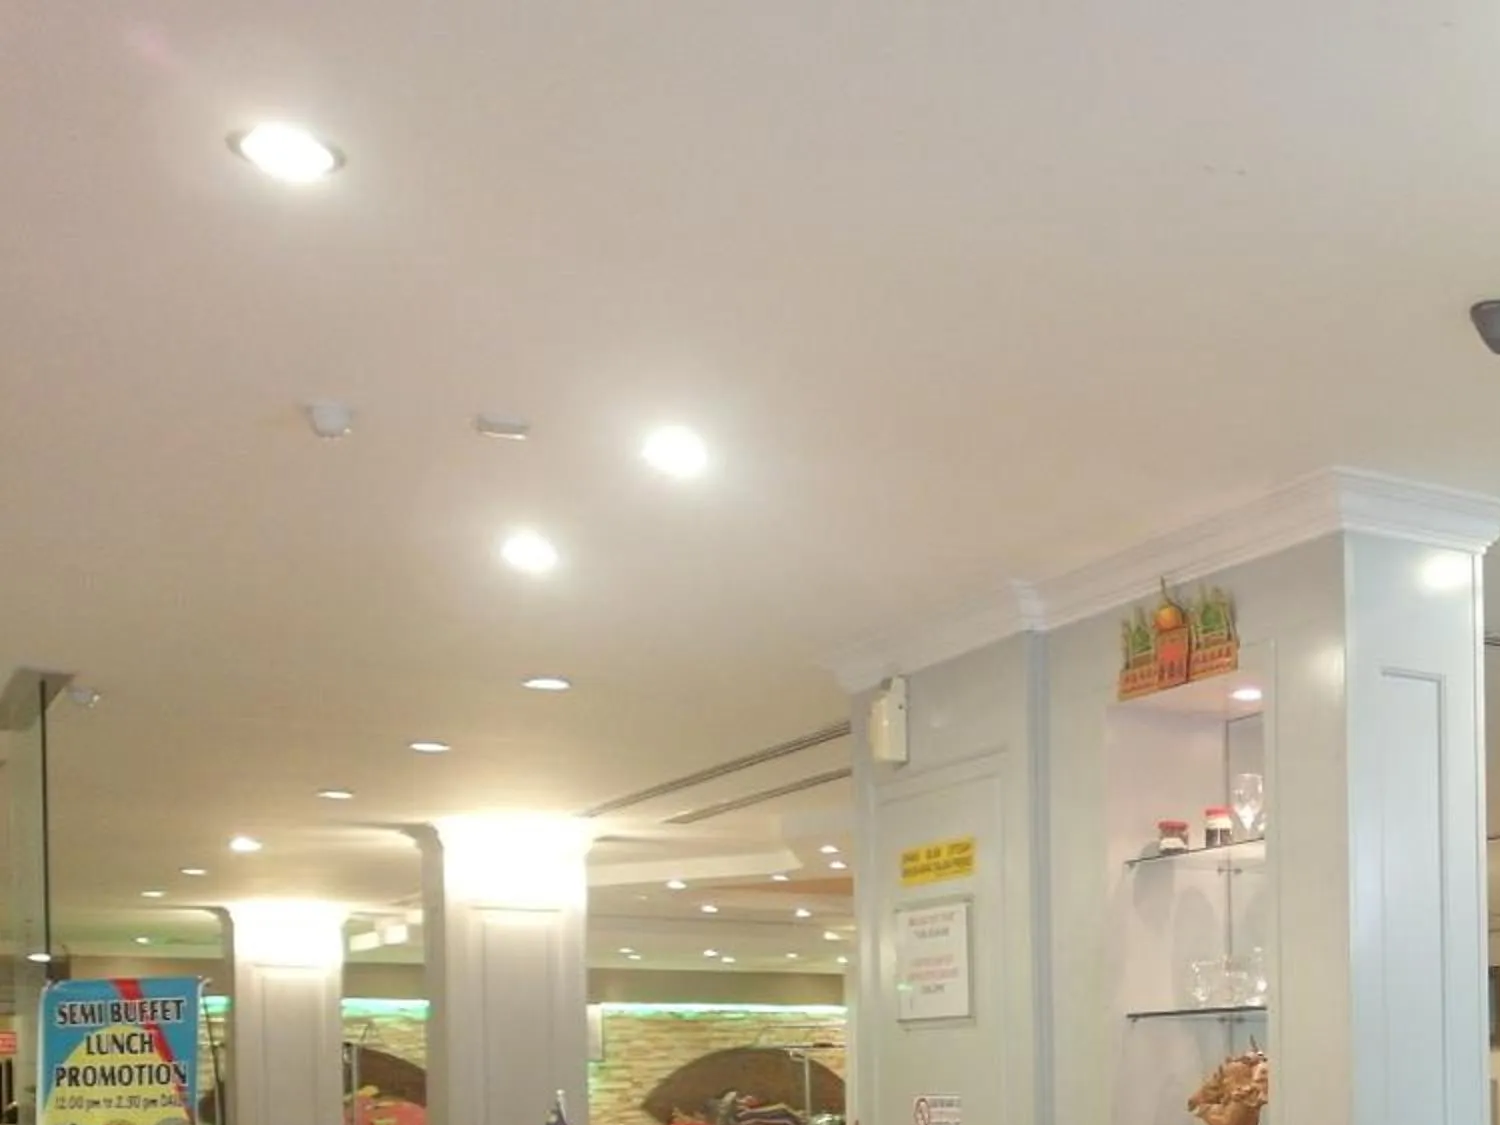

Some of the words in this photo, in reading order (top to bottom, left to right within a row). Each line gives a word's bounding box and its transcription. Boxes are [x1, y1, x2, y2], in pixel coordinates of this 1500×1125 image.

[57, 1000, 102, 1025] SEMI
[111, 999, 184, 1023] BUFFET
[85, 1033, 153, 1055] LUNCH
[55, 1063, 187, 1087] PROMOTION
